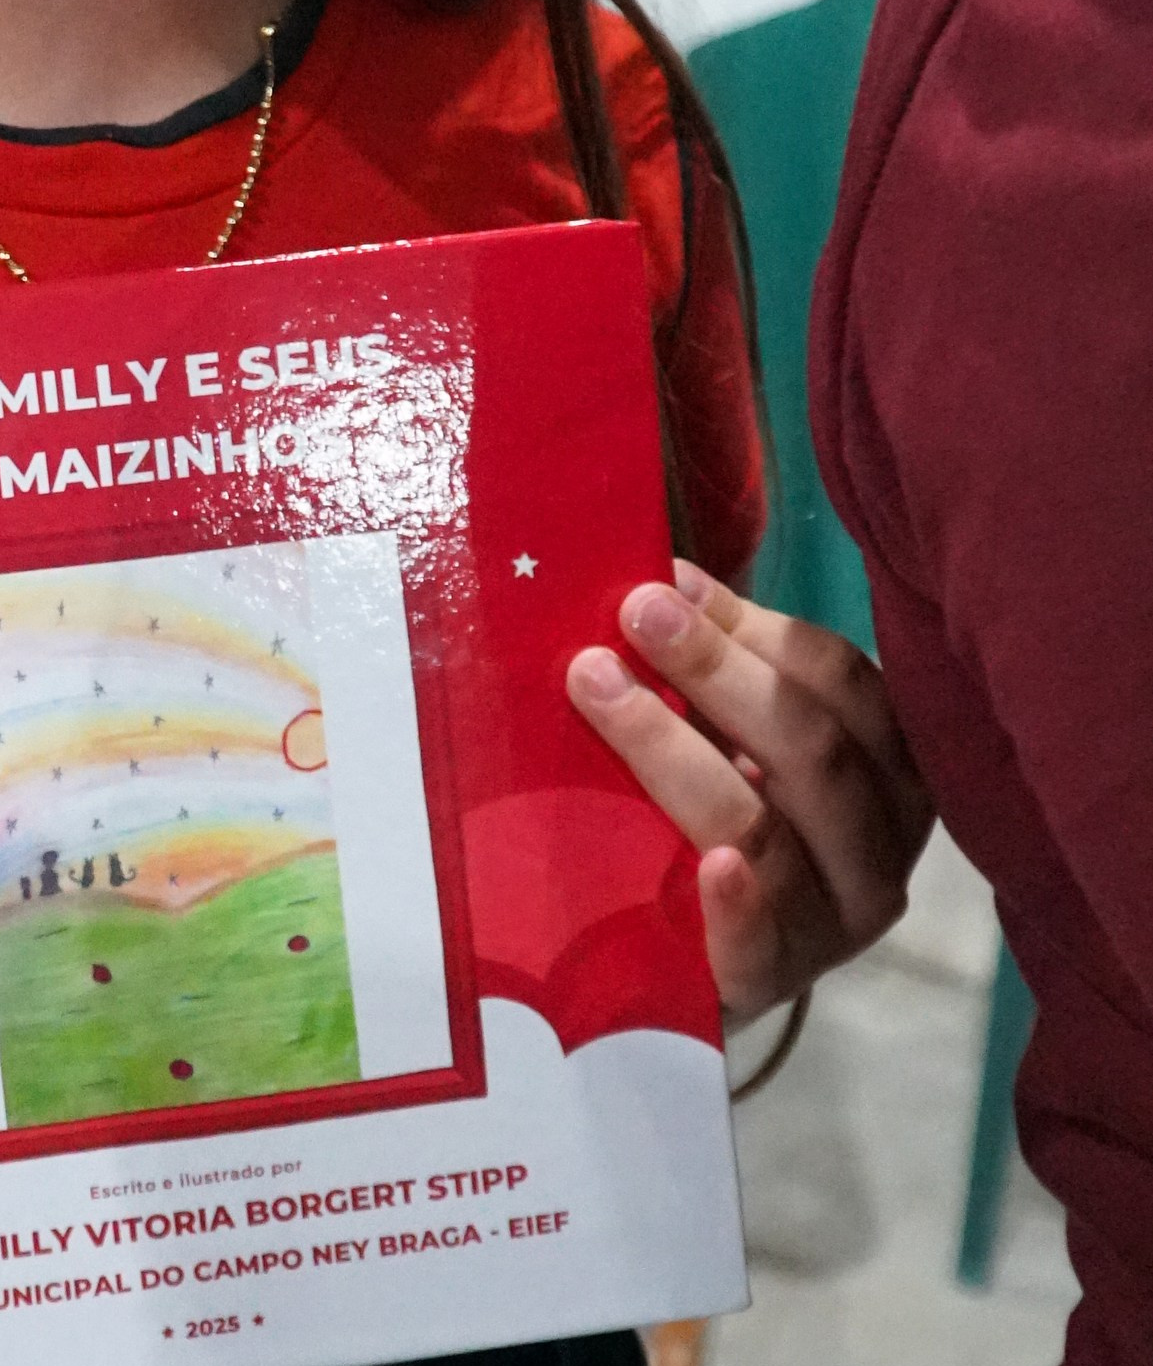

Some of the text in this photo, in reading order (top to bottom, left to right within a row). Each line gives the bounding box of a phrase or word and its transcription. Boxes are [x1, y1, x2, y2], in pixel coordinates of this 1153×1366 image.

[184, 352, 223, 398] E
[238, 332, 395, 391] SEUS
[84, 1205, 236, 1248] VITORIA
[245, 1179, 416, 1228] BORGERT
[427, 1164, 529, 1202] STIPP
[90, 1159, 302, 1200] Escrito e ilustrado por
[140, 1266, 185, 1290] DO
[193, 1249, 303, 1283] CAMPO
[312, 1239, 369, 1267] NEY
[379, 1224, 483, 1257] BRAGA
[508, 1211, 570, 1240] EIEF
[185, 1316, 241, 1339] 2025
